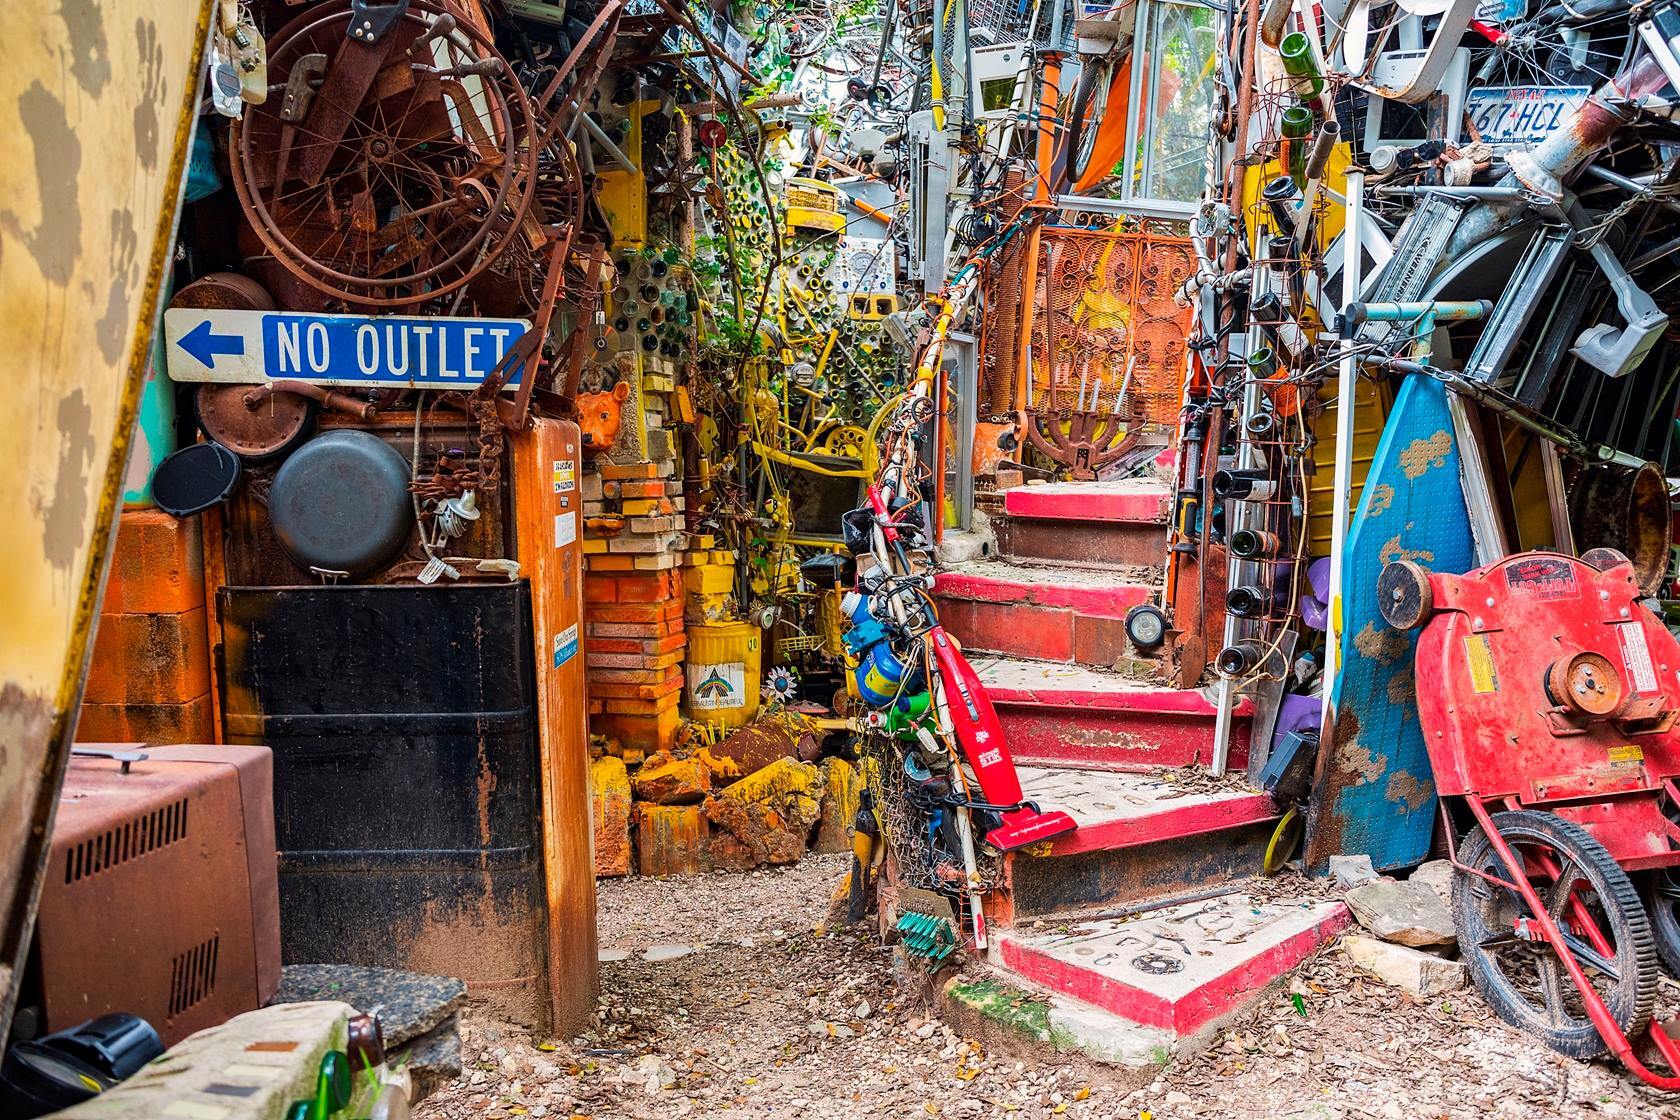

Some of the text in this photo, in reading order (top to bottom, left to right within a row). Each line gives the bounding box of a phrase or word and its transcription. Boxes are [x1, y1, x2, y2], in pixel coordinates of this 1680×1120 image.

[1506, 89, 1546, 100] TEXAS
[1514, 102, 1564, 131] HCL
[1397, 253, 1423, 296] WERNER
[277, 321, 510, 378] NO OUTLET
[748, 638, 758, 652] 10
